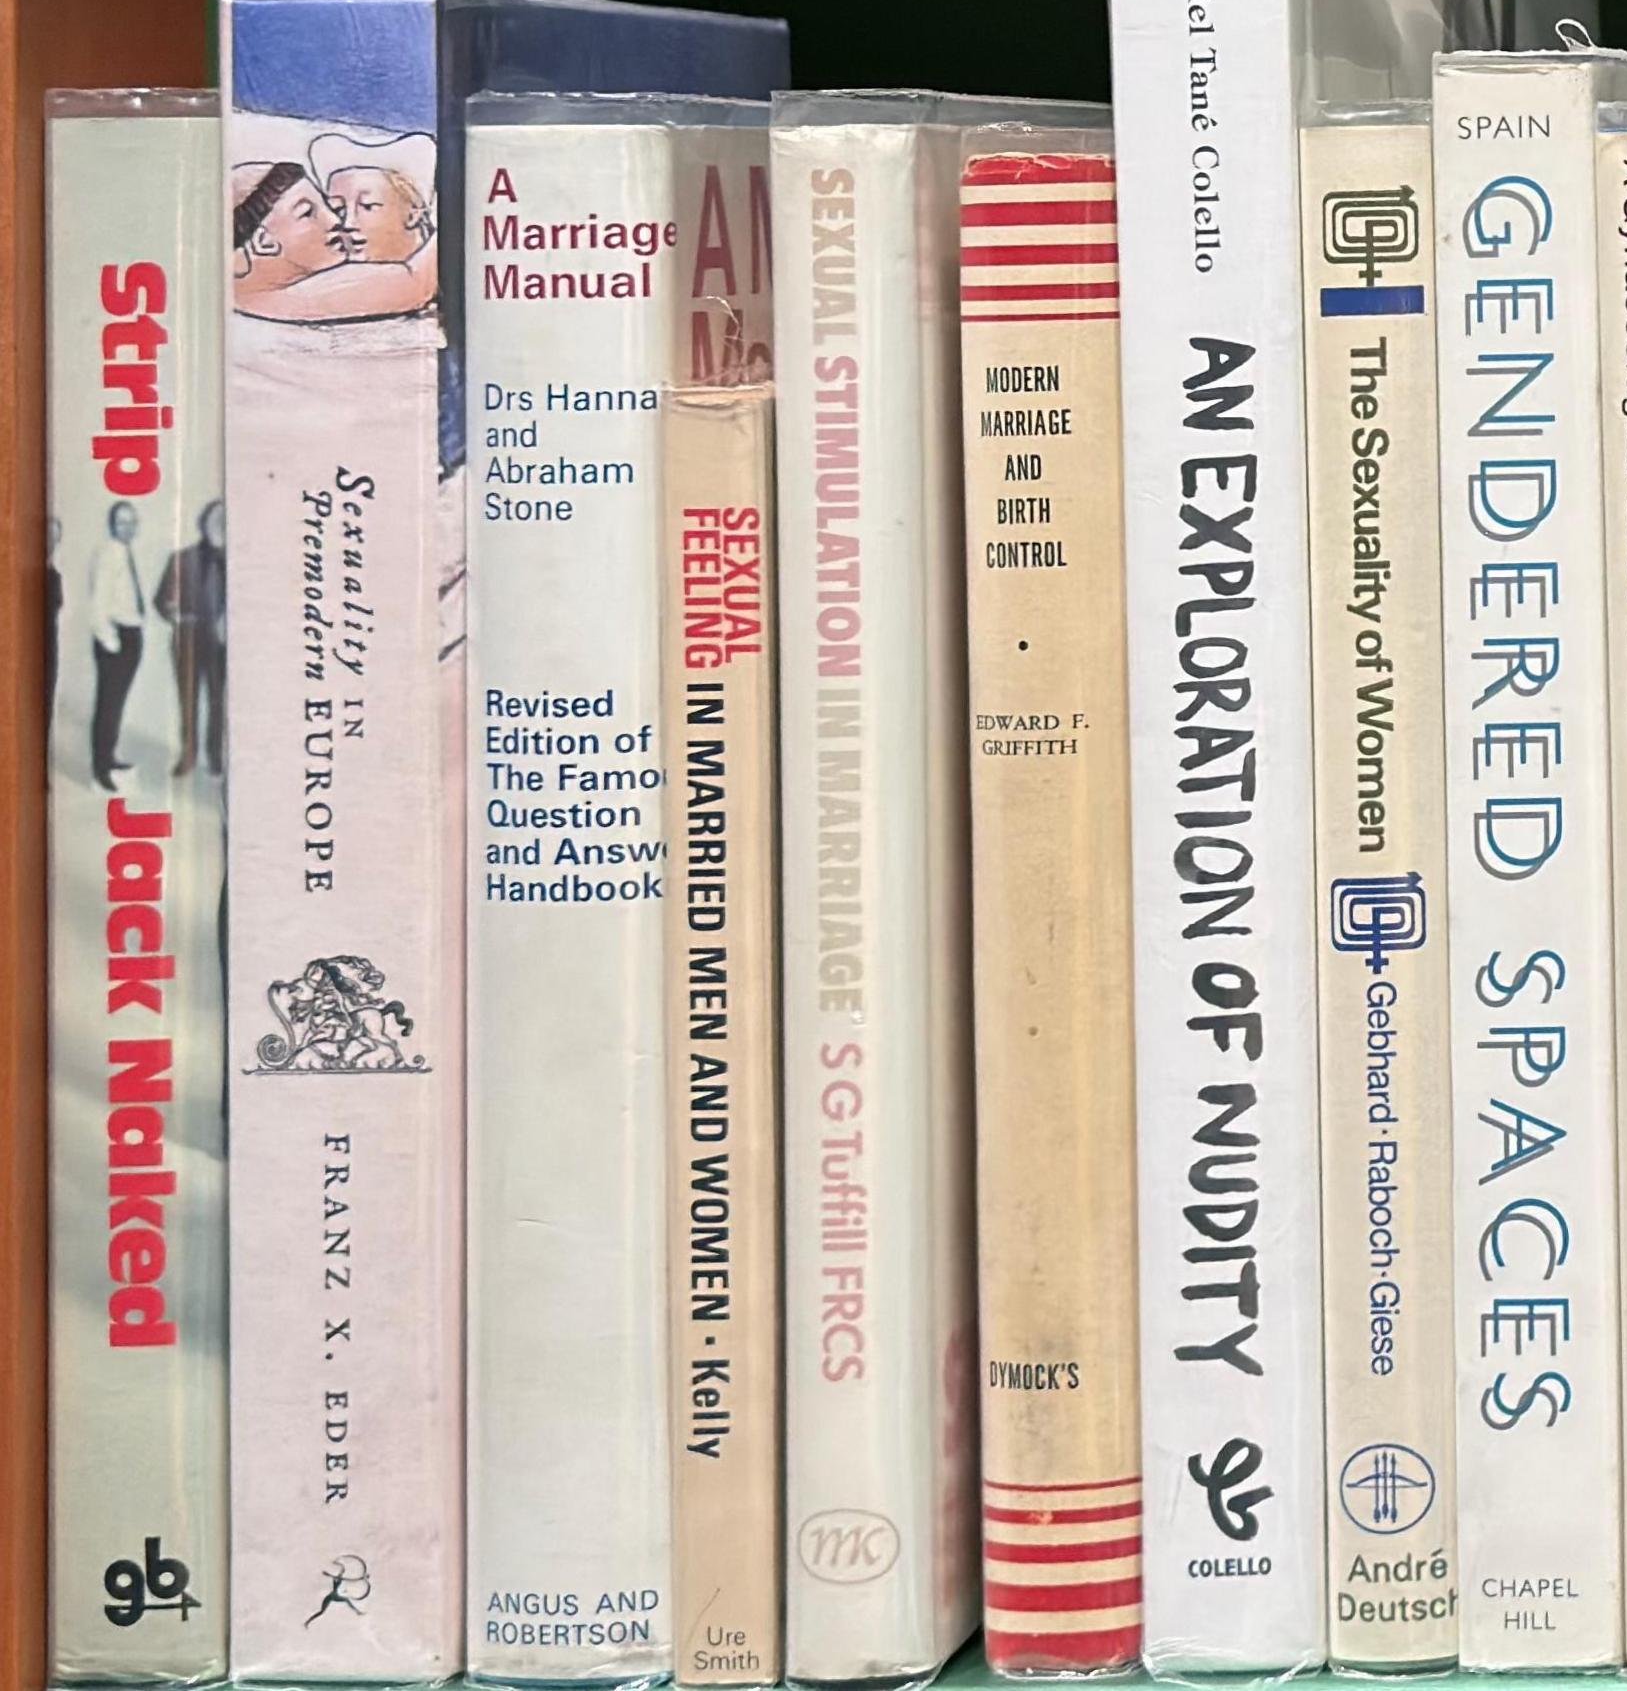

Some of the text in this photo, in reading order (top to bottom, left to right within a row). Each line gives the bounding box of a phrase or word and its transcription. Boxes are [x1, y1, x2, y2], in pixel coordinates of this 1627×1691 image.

[1190, 48, 1217, 131] Tané
[1458, 115, 1549, 139] SPAIN
[488, 168, 517, 203] A
[1191, 146, 1221, 273] Colello
[483, 213, 677, 256] Marriage
[485, 263, 650, 300] Manual
[987, 366, 1059, 392] MODERN
[487, 420, 536, 447] and
[981, 409, 1071, 436] MARRIAGE
[485, 456, 633, 484] Abraham
[1005, 454, 1041, 481] AND
[485, 492, 572, 520] Stone
[998, 498, 1050, 524] BIRTH
[987, 541, 1067, 568] CONTROL
[332, 466, 374, 738] Sexuality IN
[1347, 337, 1393, 852] The Sexuality of Women
[303, 490, 333, 892] Premodern EUROPE
[487, 689, 612, 718] Revised
[977, 714, 1089, 730] EDWARD F.
[487, 725, 651, 755] Edition of
[983, 739, 1077, 755] GRIFFITH
[93, 263, 176, 1346] Strip Jack Naked
[488, 800, 640, 828] Question
[1463, 176, 1571, 1430] GENDERED SPACES
[1173, 338, 1263, 1376] AN EXPLORATION OF NUDITY
[487, 872, 663, 902] Handbook
[324, 1134, 350, 1503] FRANZ X. EDER
[990, 1361, 1078, 1390] DYMOCK'S
[1188, 1557, 1271, 1578] COLELLO
[1348, 1548, 1447, 1582] André
[1482, 1579, 1578, 1597] CHAPEL
[488, 1590, 658, 1616] ANGUS AND
[487, 1620, 648, 1645] ROBERTSON
[1505, 1612, 1556, 1630] HILL
[707, 1626, 745, 1646] Ure
[694, 1651, 759, 1670] Smith
